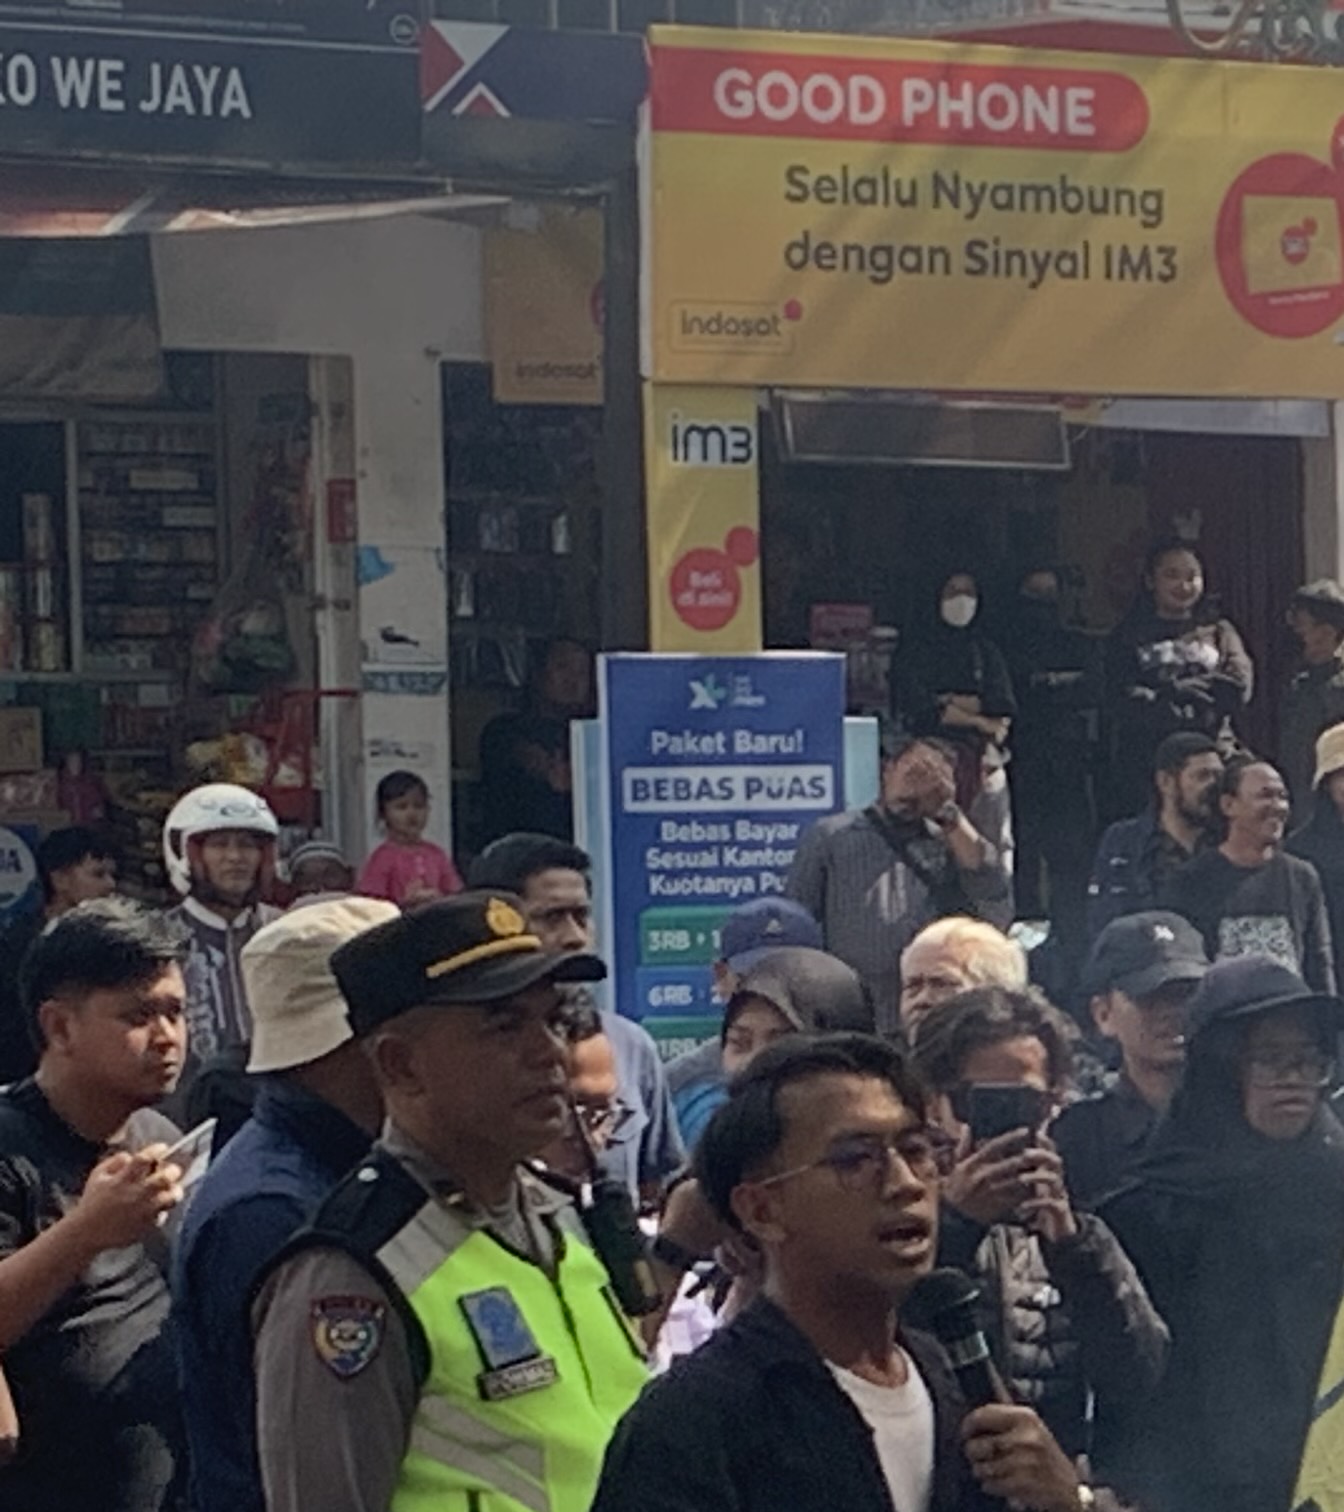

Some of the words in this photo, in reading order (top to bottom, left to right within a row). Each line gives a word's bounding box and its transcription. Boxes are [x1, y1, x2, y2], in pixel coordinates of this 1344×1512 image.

[0, 53, 37, 106] O
[50, 56, 125, 111] WE
[139, 63, 251, 119] JAYA
[713, 68, 885, 126] GOOD
[902, 77, 1097, 136] PHONE
[784, 165, 918, 208] Selalu
[932, 171, 1165, 229] Nyambung
[784, 231, 952, 285] dengan
[964, 239, 1091, 289] Sinyal
[1103, 245, 1178, 283] IM3
[651, 730, 726, 754] Paket
[733, 729, 804, 753] Baru!
[631, 777, 734, 802] BEBAS
[744, 775, 826, 801] PUAS
[661, 821, 731, 843] Bebas
[735, 819, 799, 844] Bayar
[646, 847, 719, 869] Sesuai
[650, 872, 755, 898] Kuotanya
[649, 929, 692, 950] 3RB
